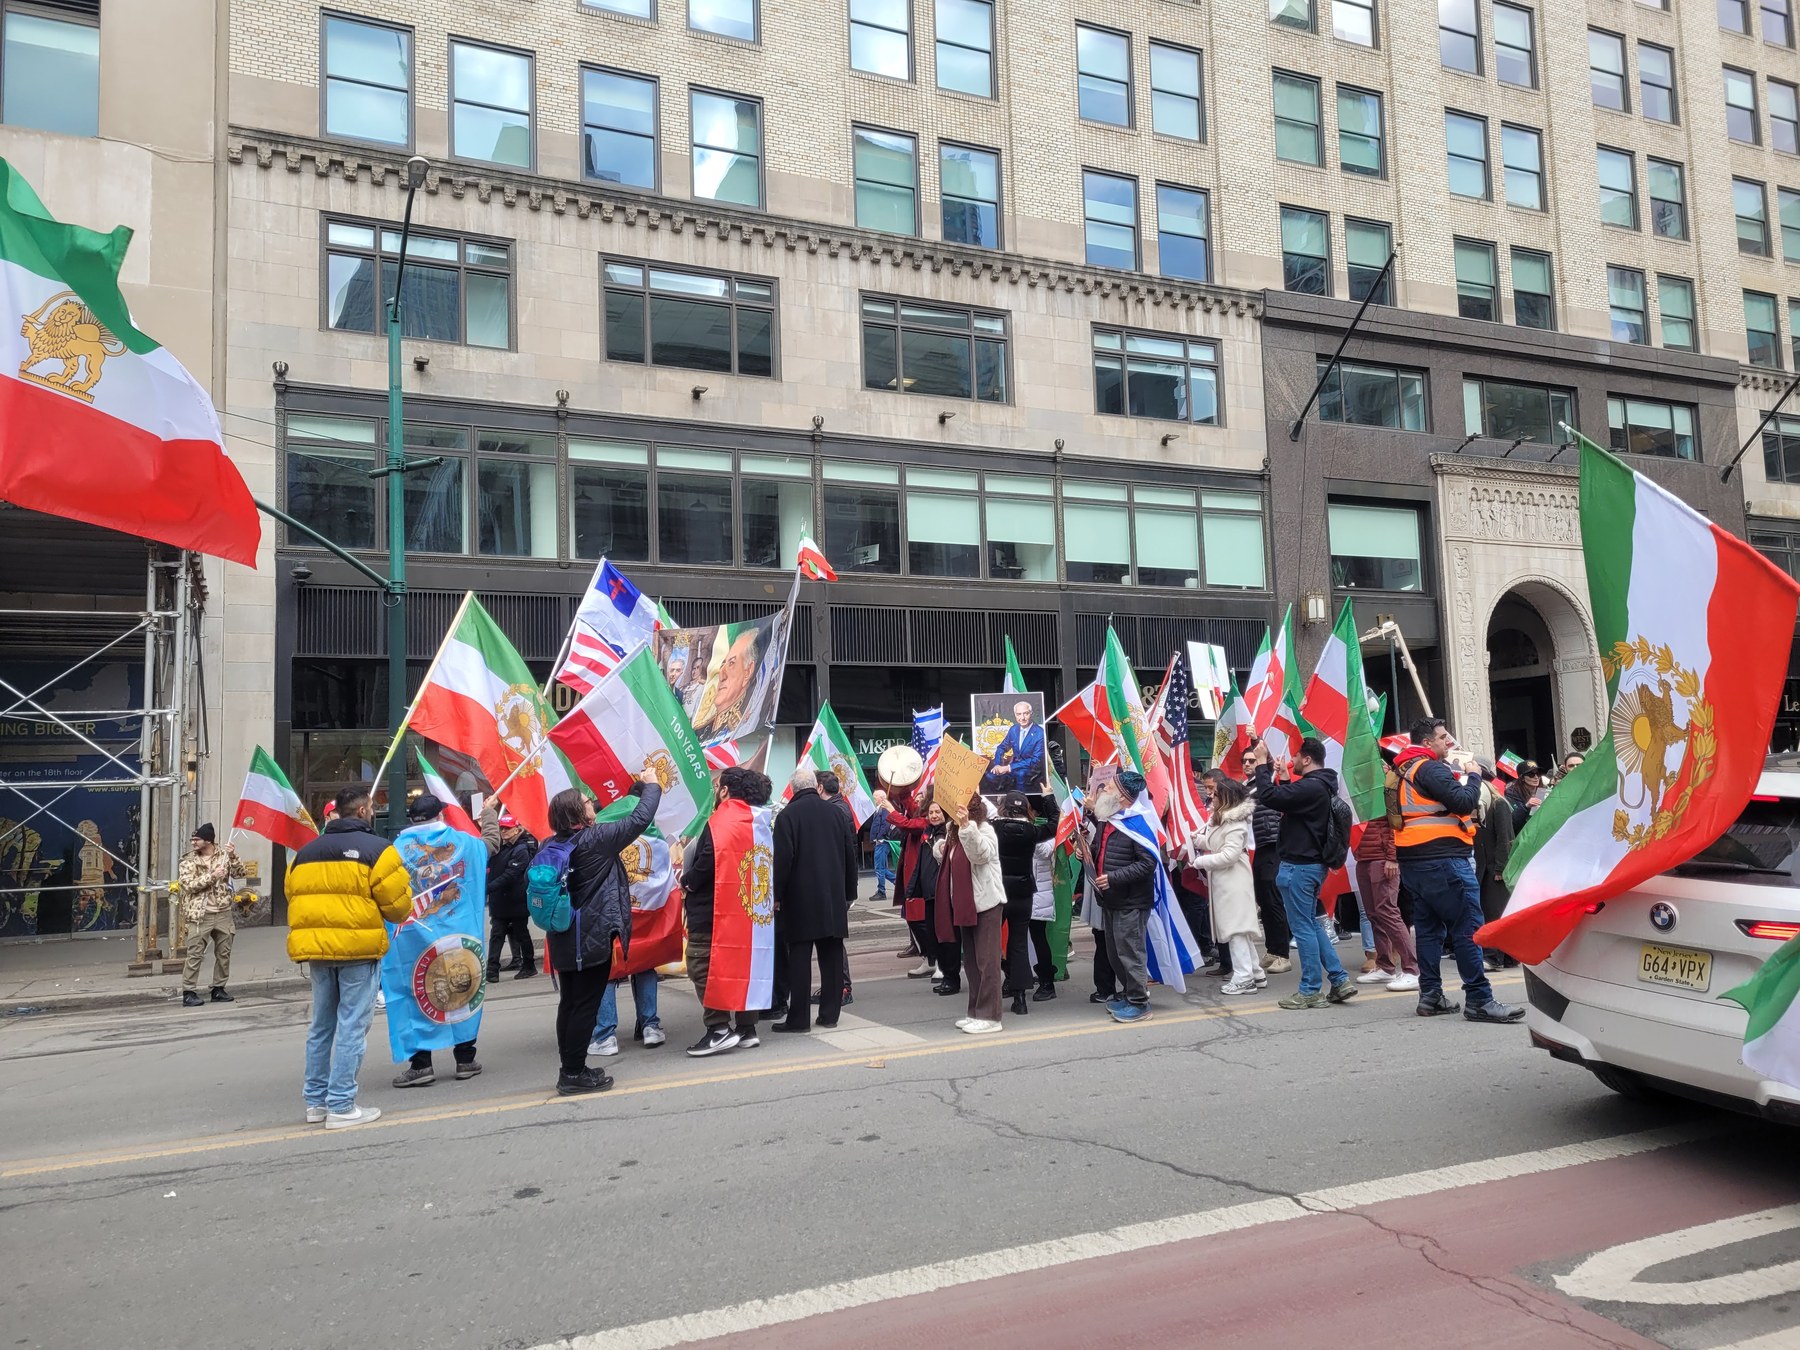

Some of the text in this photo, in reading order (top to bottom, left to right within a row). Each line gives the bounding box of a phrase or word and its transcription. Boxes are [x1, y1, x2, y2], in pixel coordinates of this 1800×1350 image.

[1783, 694, 1800, 712] Le
[35, 722, 96, 735] BIGGER
[670, 715, 706, 779] 100 YEARS
[944, 739, 970, 767] Thank
[64, 768, 83, 776] floor
[940, 767, 965, 797] Trump
[1656, 946, 1693, 959] New Jersey
[1643, 953, 1705, 981] G64 VPX
[1654, 974, 1690, 986] Garden State
